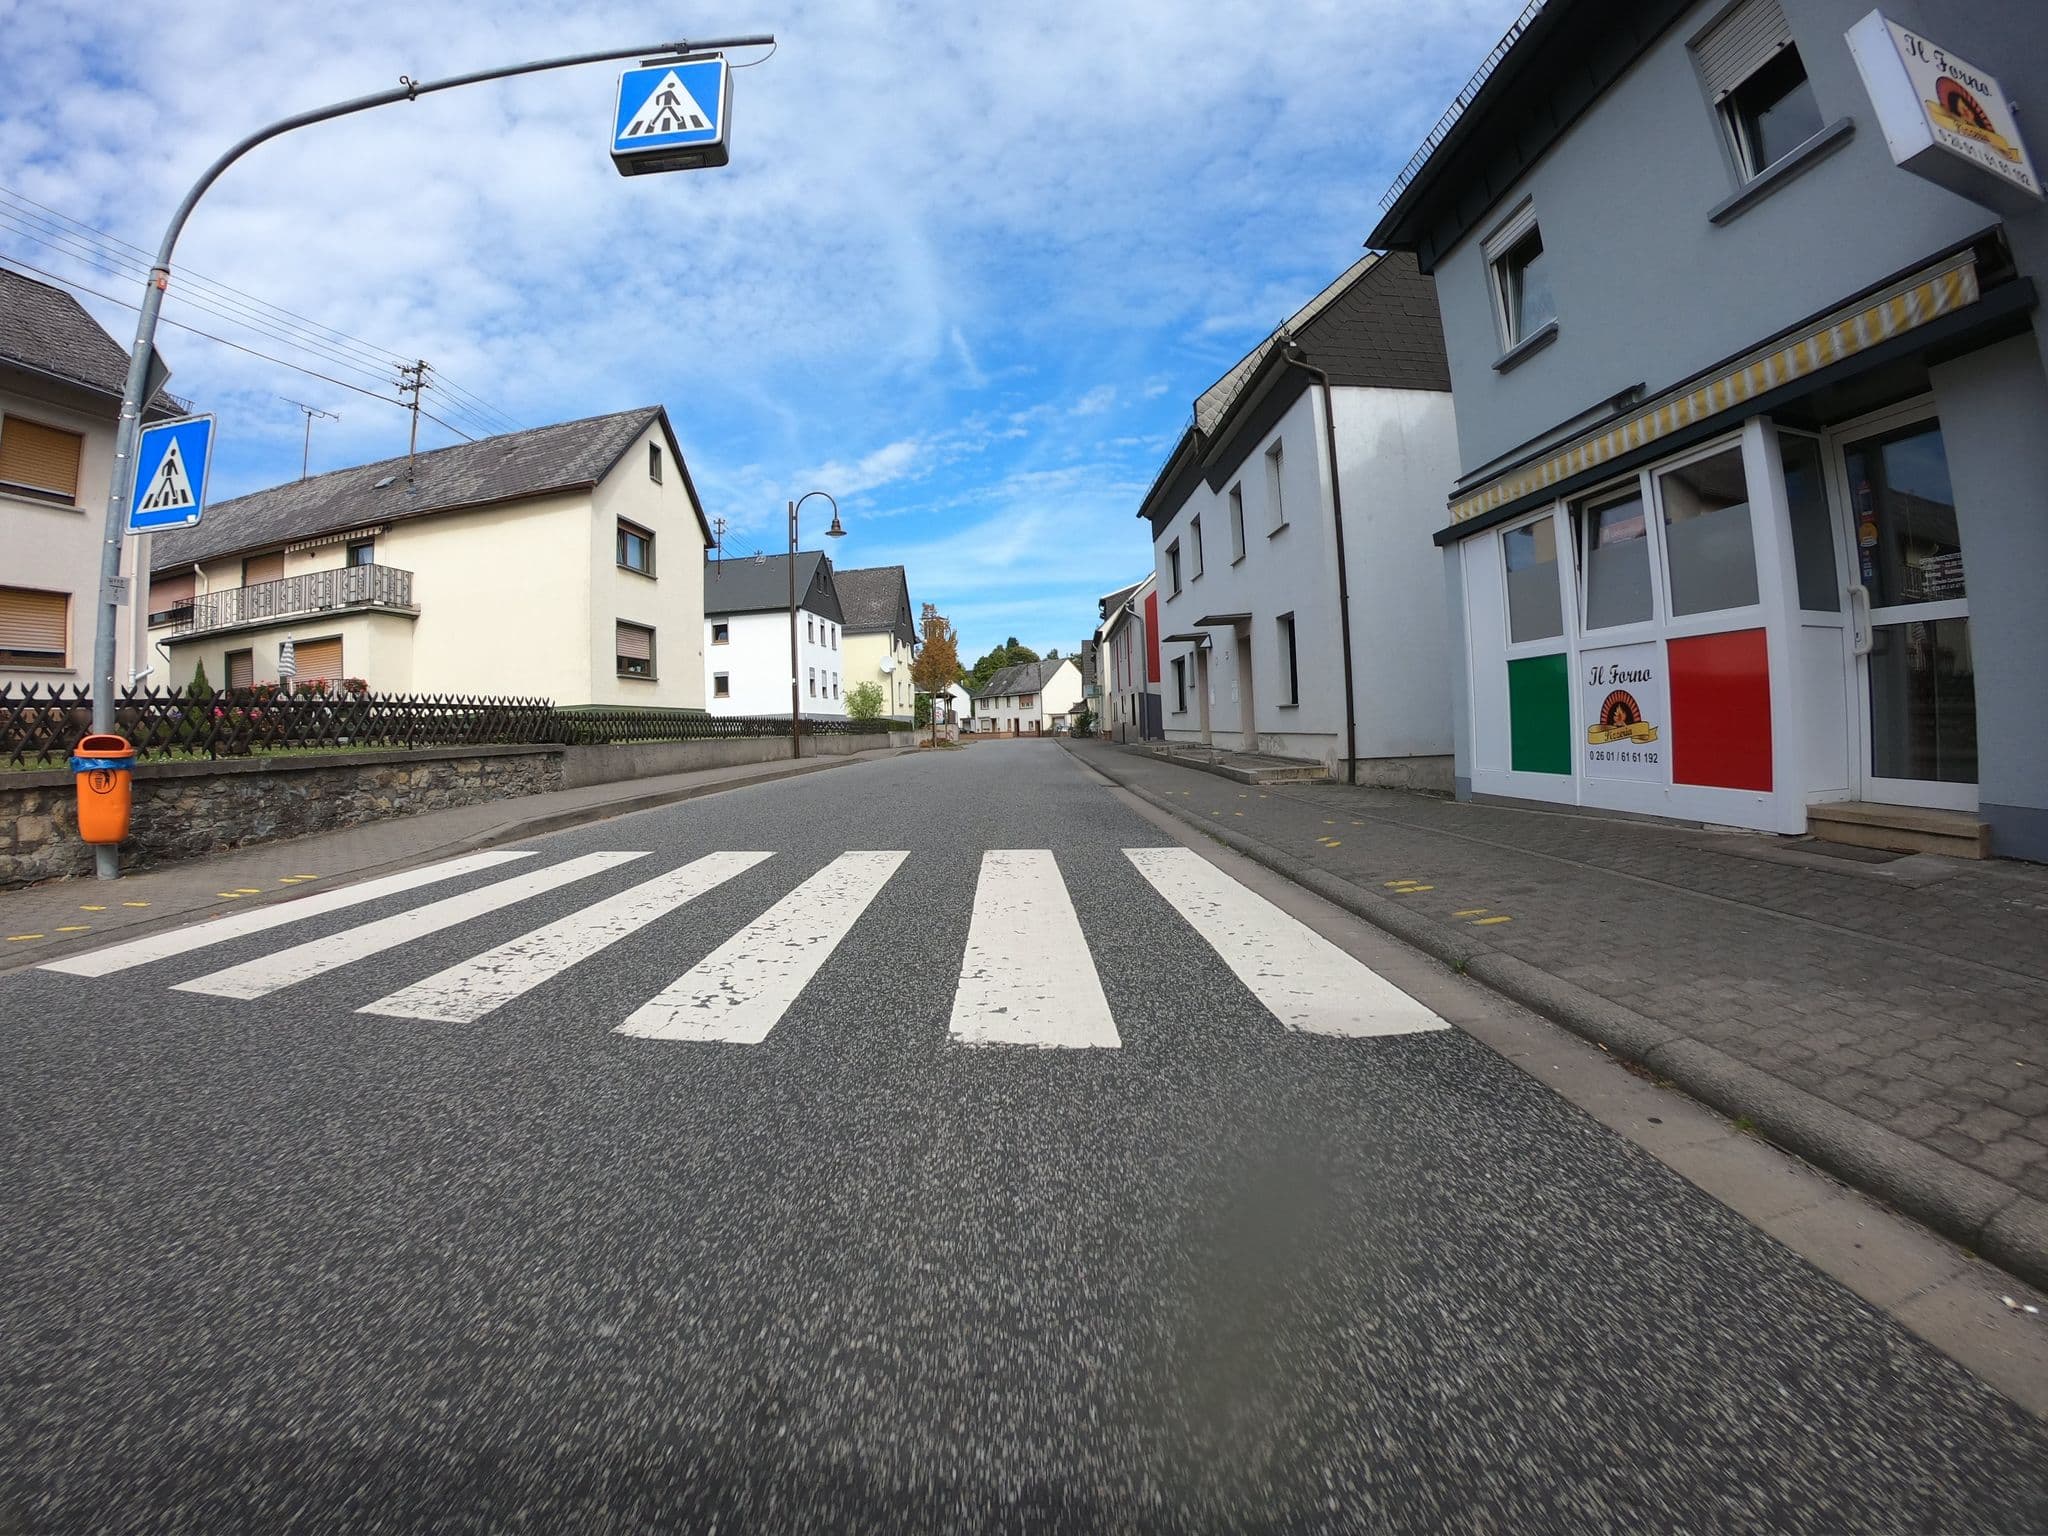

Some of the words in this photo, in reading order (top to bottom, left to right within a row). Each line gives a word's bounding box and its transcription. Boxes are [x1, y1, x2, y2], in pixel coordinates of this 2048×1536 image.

[1903, 33, 1930, 63] Il
[1934, 50, 1993, 97] Forno
[1589, 665, 1605, 686] Il
[1608, 664, 1652, 685] Forno
[1621, 752, 1630, 762] 61
[1632, 752, 1641, 763] 61
[1644, 752, 1659, 764] 192
